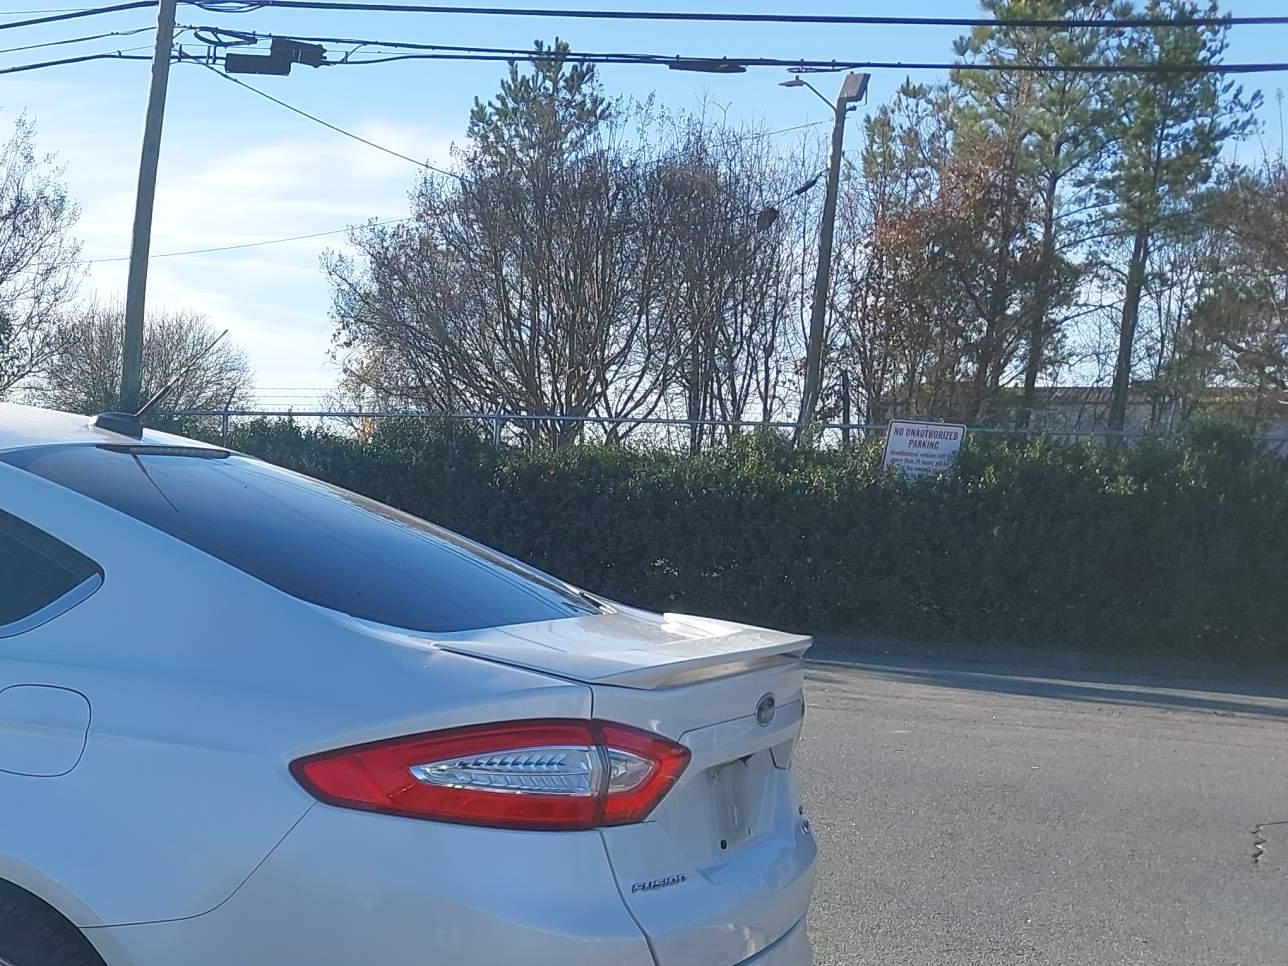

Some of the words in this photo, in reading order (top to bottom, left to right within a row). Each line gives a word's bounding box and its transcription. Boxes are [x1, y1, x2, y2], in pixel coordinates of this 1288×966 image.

[894, 427, 904, 436] NO
[906, 428, 959, 440] UNAUTHORIZED
[908, 440, 940, 449] PARKING
